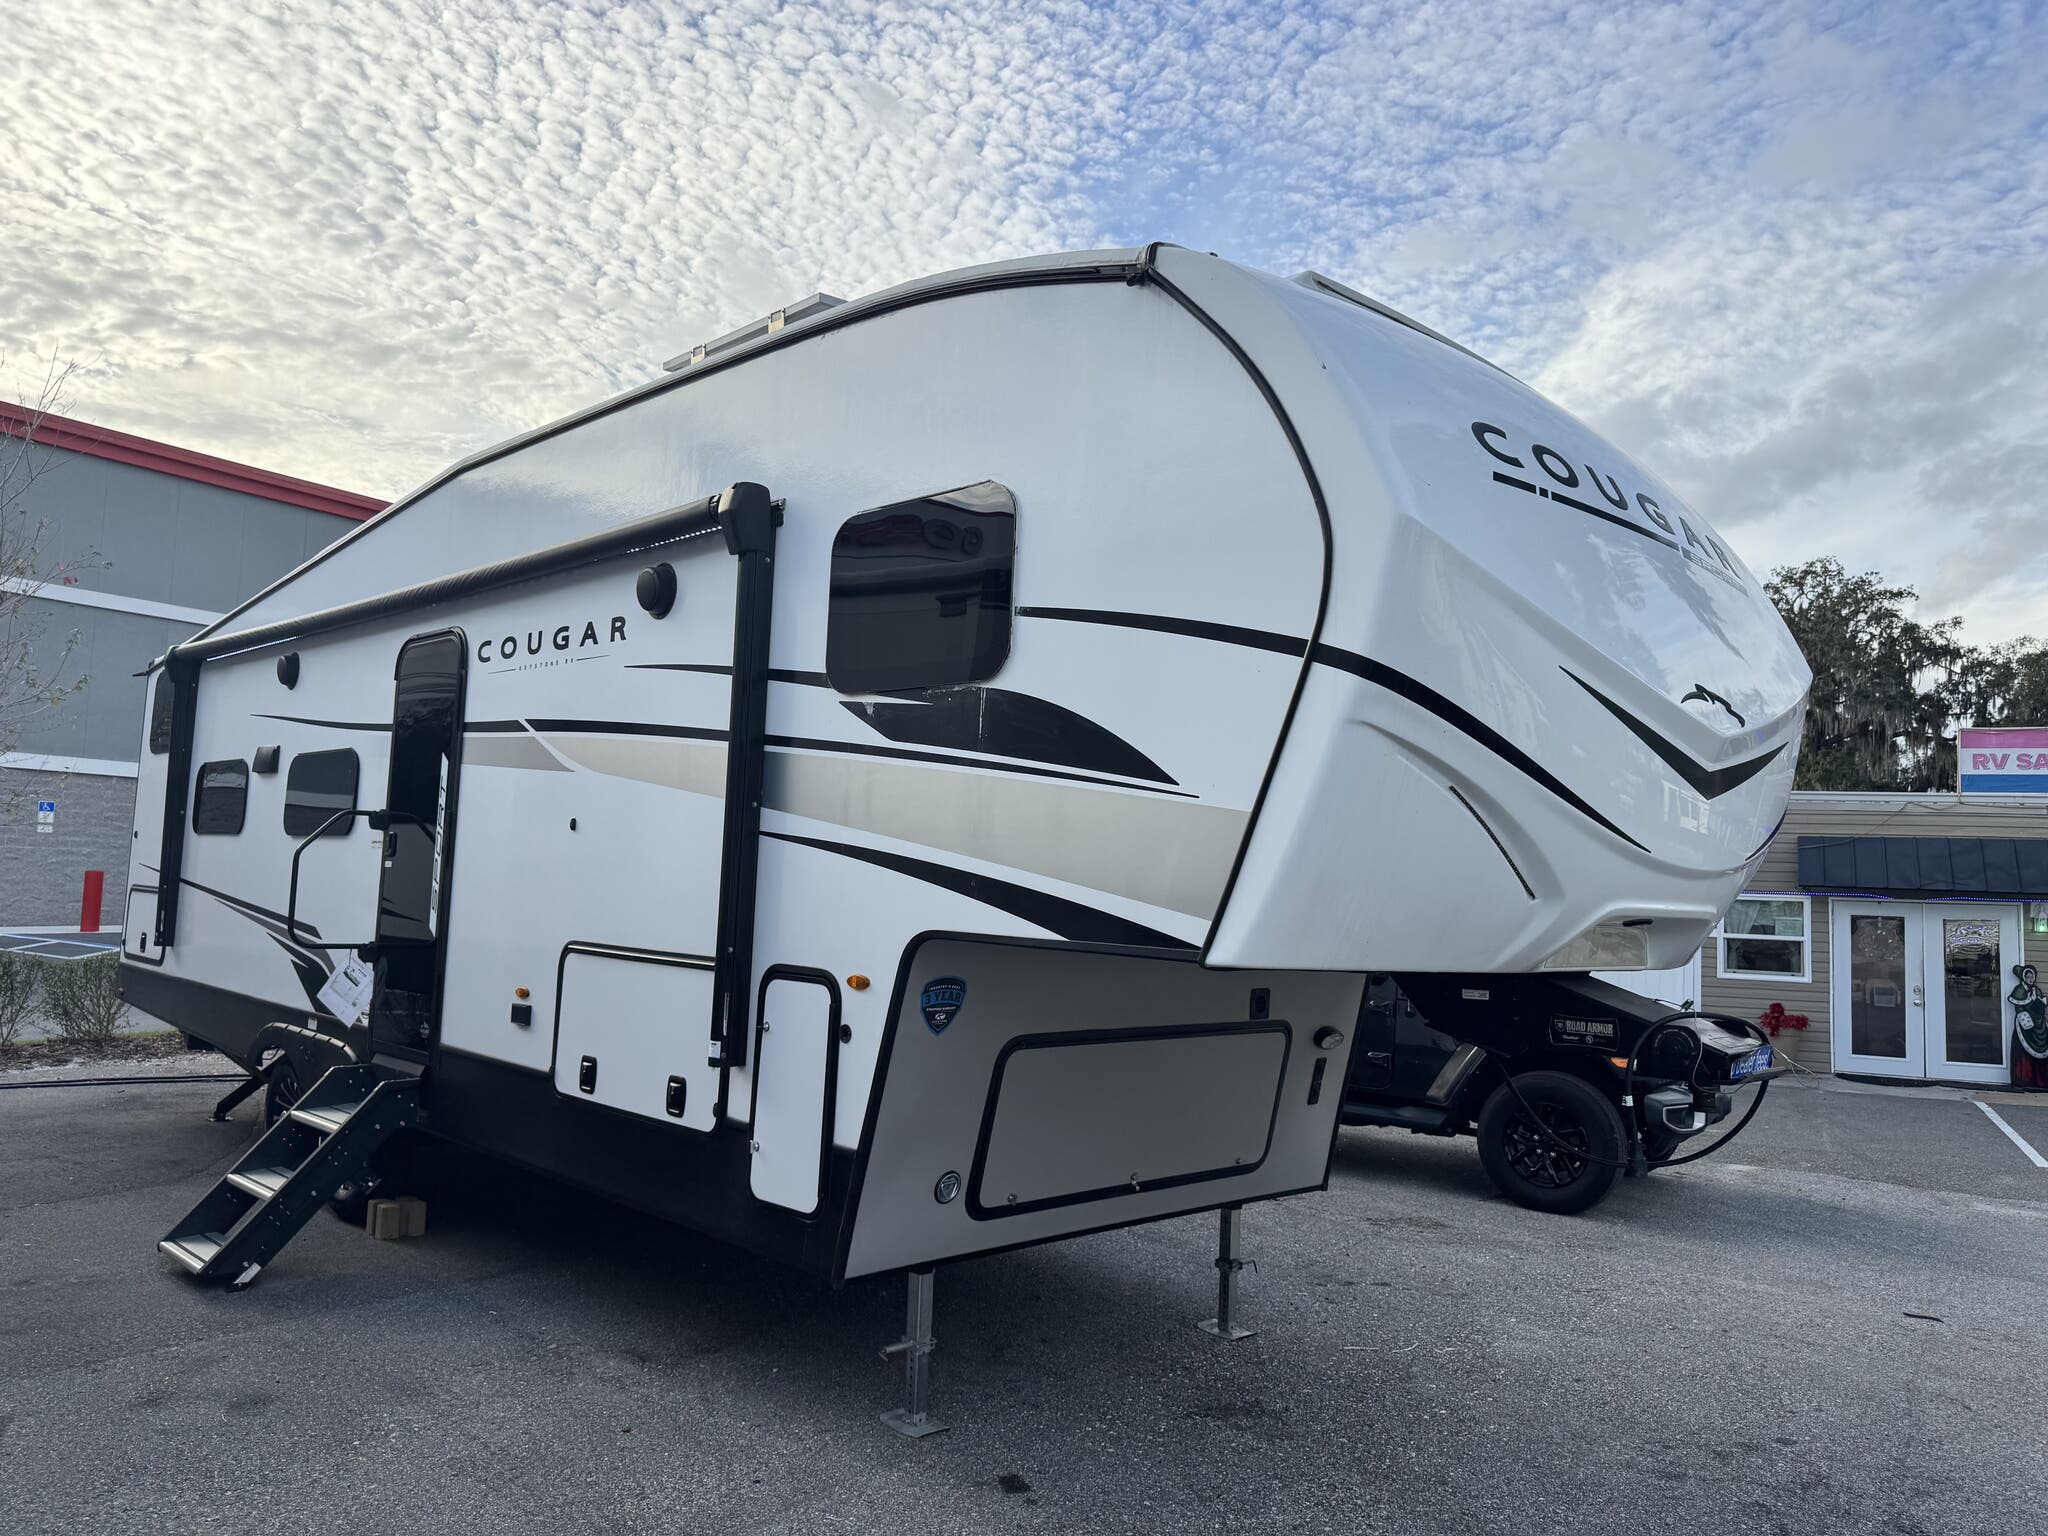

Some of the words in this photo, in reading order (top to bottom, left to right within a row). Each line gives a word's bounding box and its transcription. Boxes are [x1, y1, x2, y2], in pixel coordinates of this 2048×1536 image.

[1471, 421, 1743, 581] COUGAR
[477, 616, 627, 663] COUGAR
[518, 660, 559, 671] KEYSTONE
[1972, 753, 2010, 770] RV
[2016, 753, 2048, 770] SA
[432, 775, 446, 914] SPORT
[935, 991, 962, 1004] YEAR
[1566, 1020, 1586, 1031] ROAD
[1587, 1022, 1614, 1035] ARMOR
